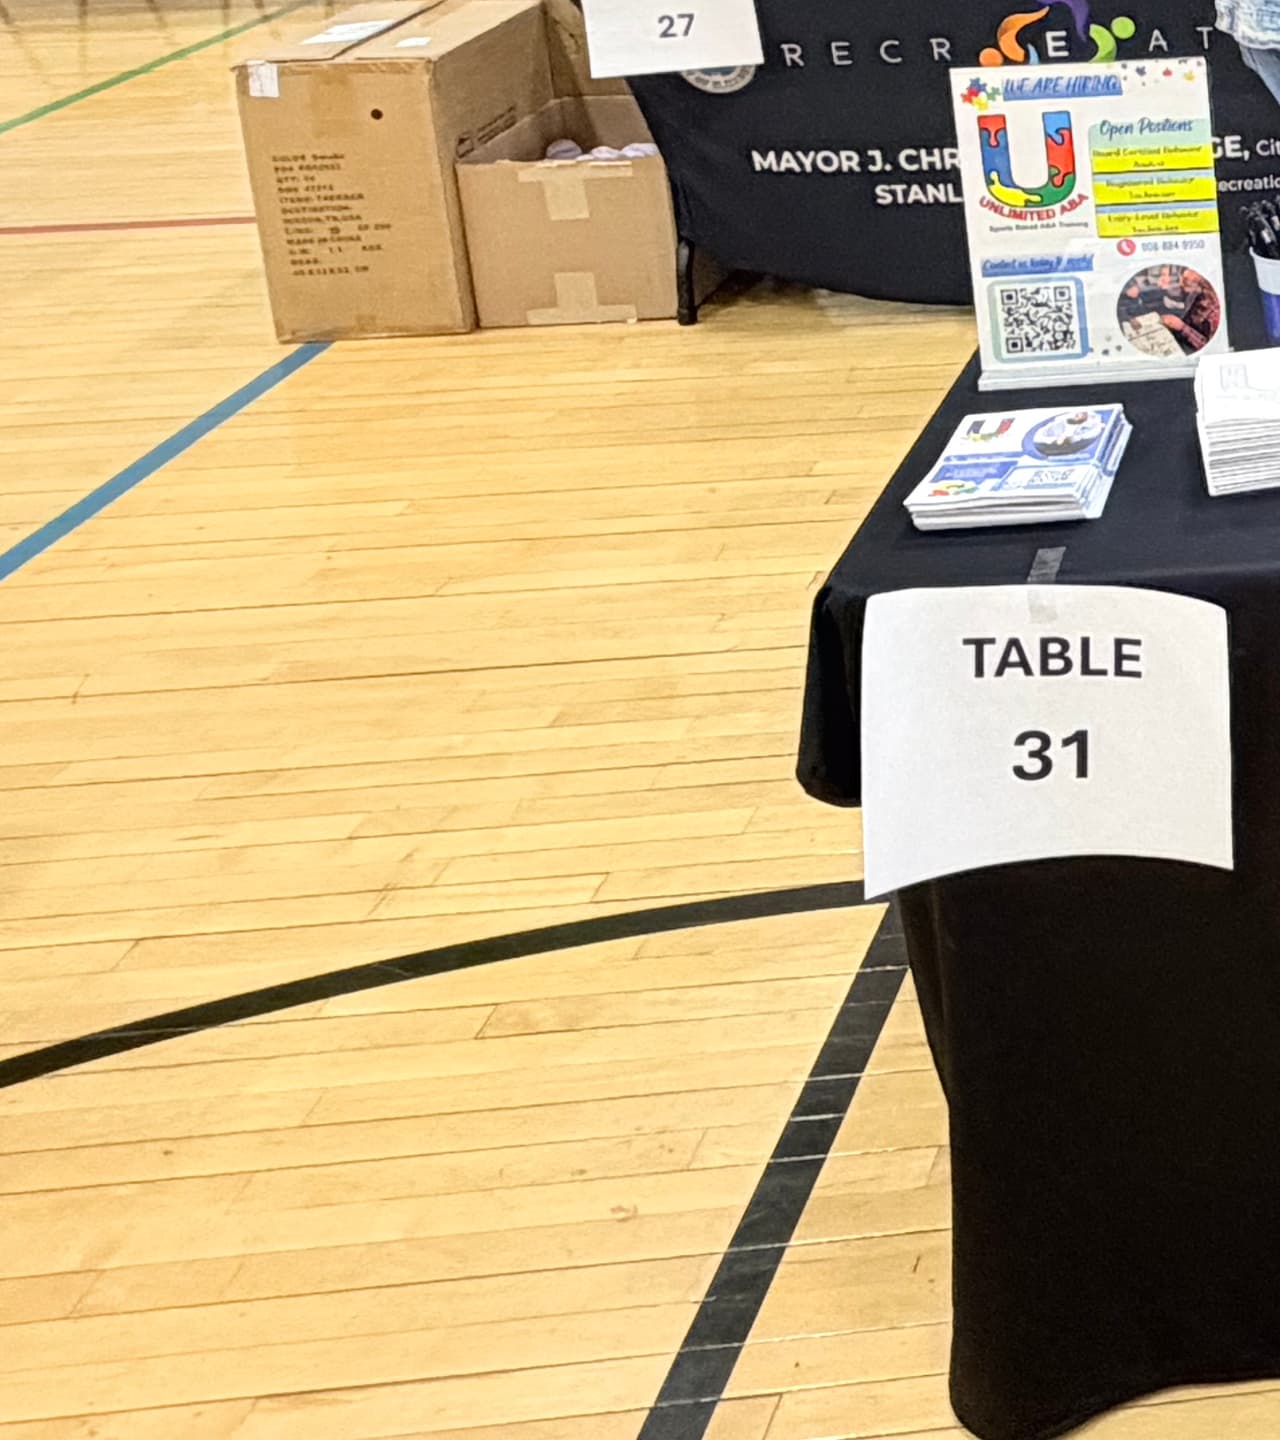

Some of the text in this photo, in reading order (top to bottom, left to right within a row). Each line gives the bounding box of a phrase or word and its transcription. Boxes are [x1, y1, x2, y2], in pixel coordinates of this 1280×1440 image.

[657, 13, 696, 40] 27
[780, 26, 1217, 67] RECREAT
[1100, 119, 1134, 141] Open
[751, 148, 961, 172] MAYOR J. CHR
[1211, 135, 1250, 161] GE,
[874, 183, 965, 205] STANL
[979, 195, 1056, 221] UNLIMITED
[962, 636, 1143, 679] TABLE
[1012, 729, 1089, 781] 31
